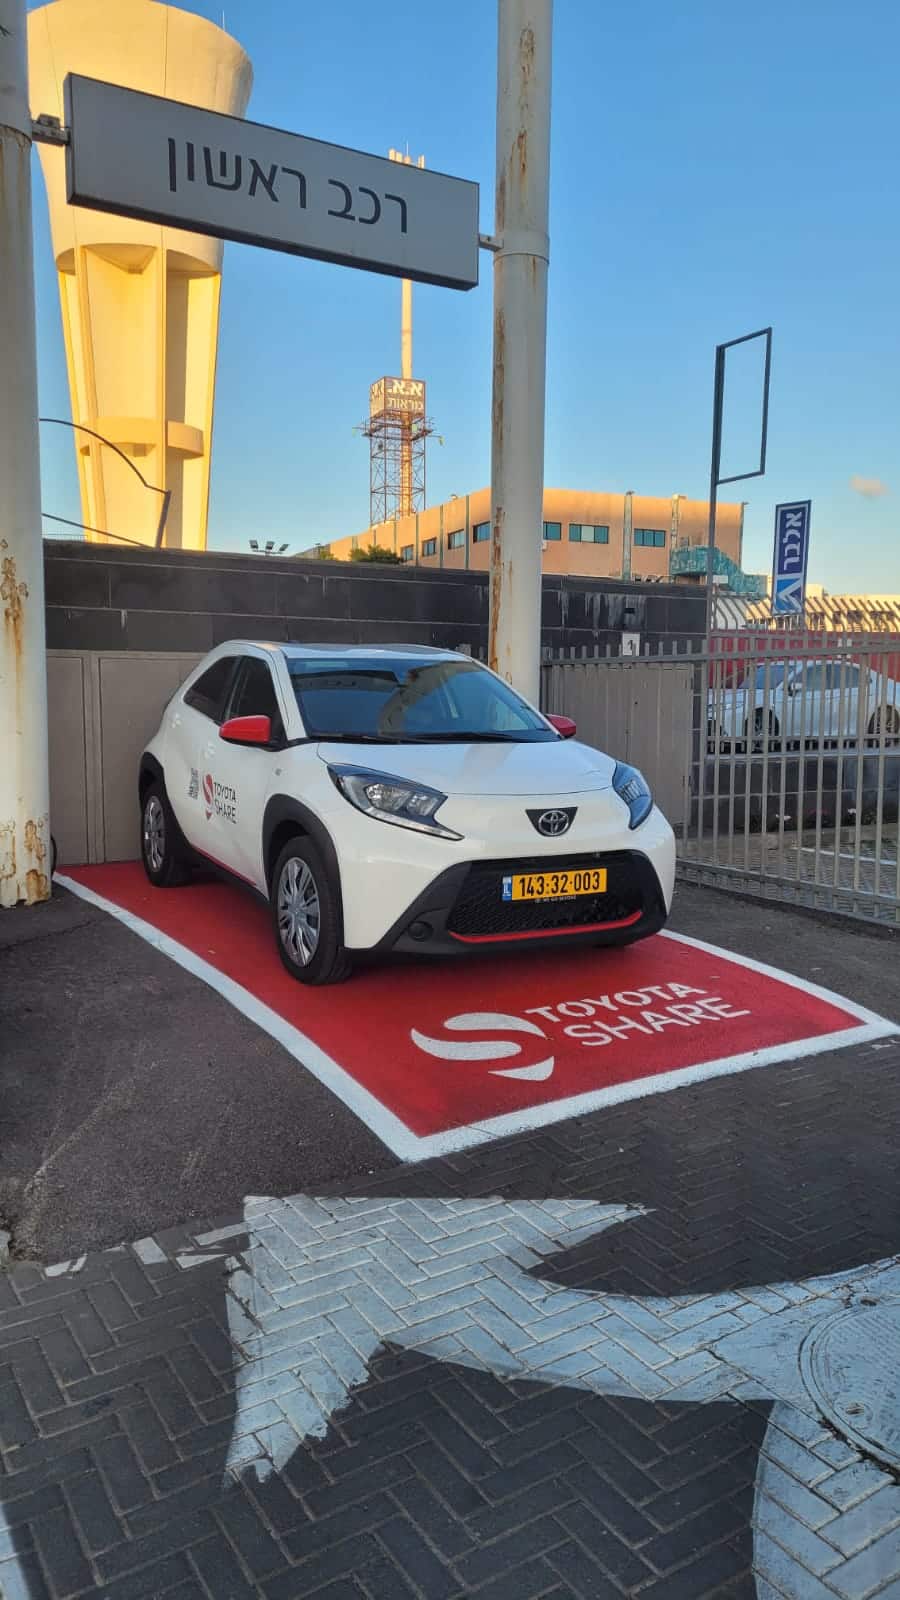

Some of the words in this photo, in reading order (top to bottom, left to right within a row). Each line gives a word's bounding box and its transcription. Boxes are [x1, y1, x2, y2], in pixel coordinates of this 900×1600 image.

[167, 136, 307, 209] ראשון
[327, 178, 408, 234] רכב
[782, 511, 803, 571] אלבר
[213, 782, 237, 803] TOYOTA
[214, 798, 237, 818] SHARE
[524, 982, 707, 1023] TOYOTA
[562, 996, 751, 1047] SHARE
